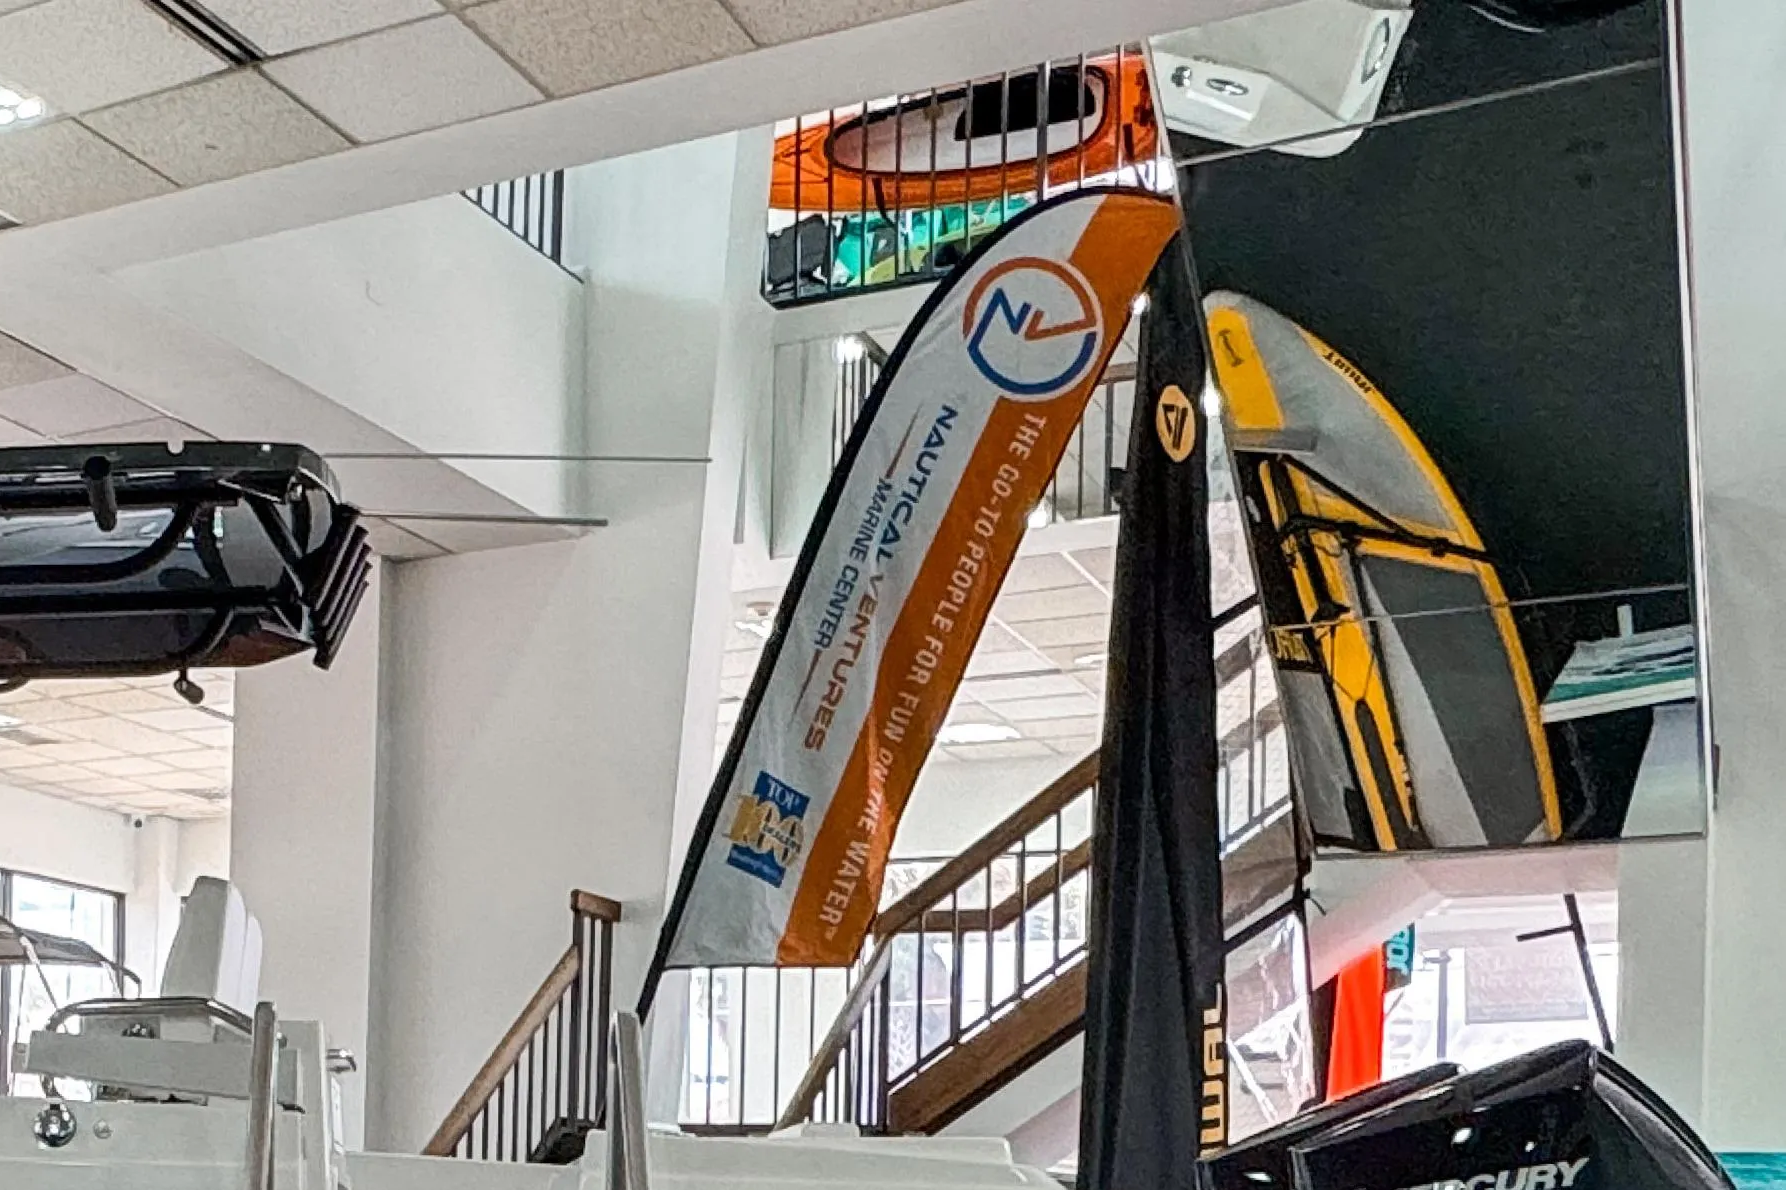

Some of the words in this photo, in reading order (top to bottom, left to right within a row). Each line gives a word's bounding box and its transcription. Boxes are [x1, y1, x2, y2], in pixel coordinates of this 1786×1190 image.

[1008, 412, 1048, 461] THE
[849, 477, 893, 562] MARINE
[875, 404, 959, 562] NAUTICAL
[973, 462, 1020, 538] GO-TO
[813, 564, 859, 650] CENTER
[930, 539, 987, 634] PEOPLE
[804, 572, 884, 752] VENTURES
[905, 634, 945, 686] FOR
[883, 691, 920, 744] FUN
[873, 751, 894, 784] ON
[857, 787, 884, 836] THE
